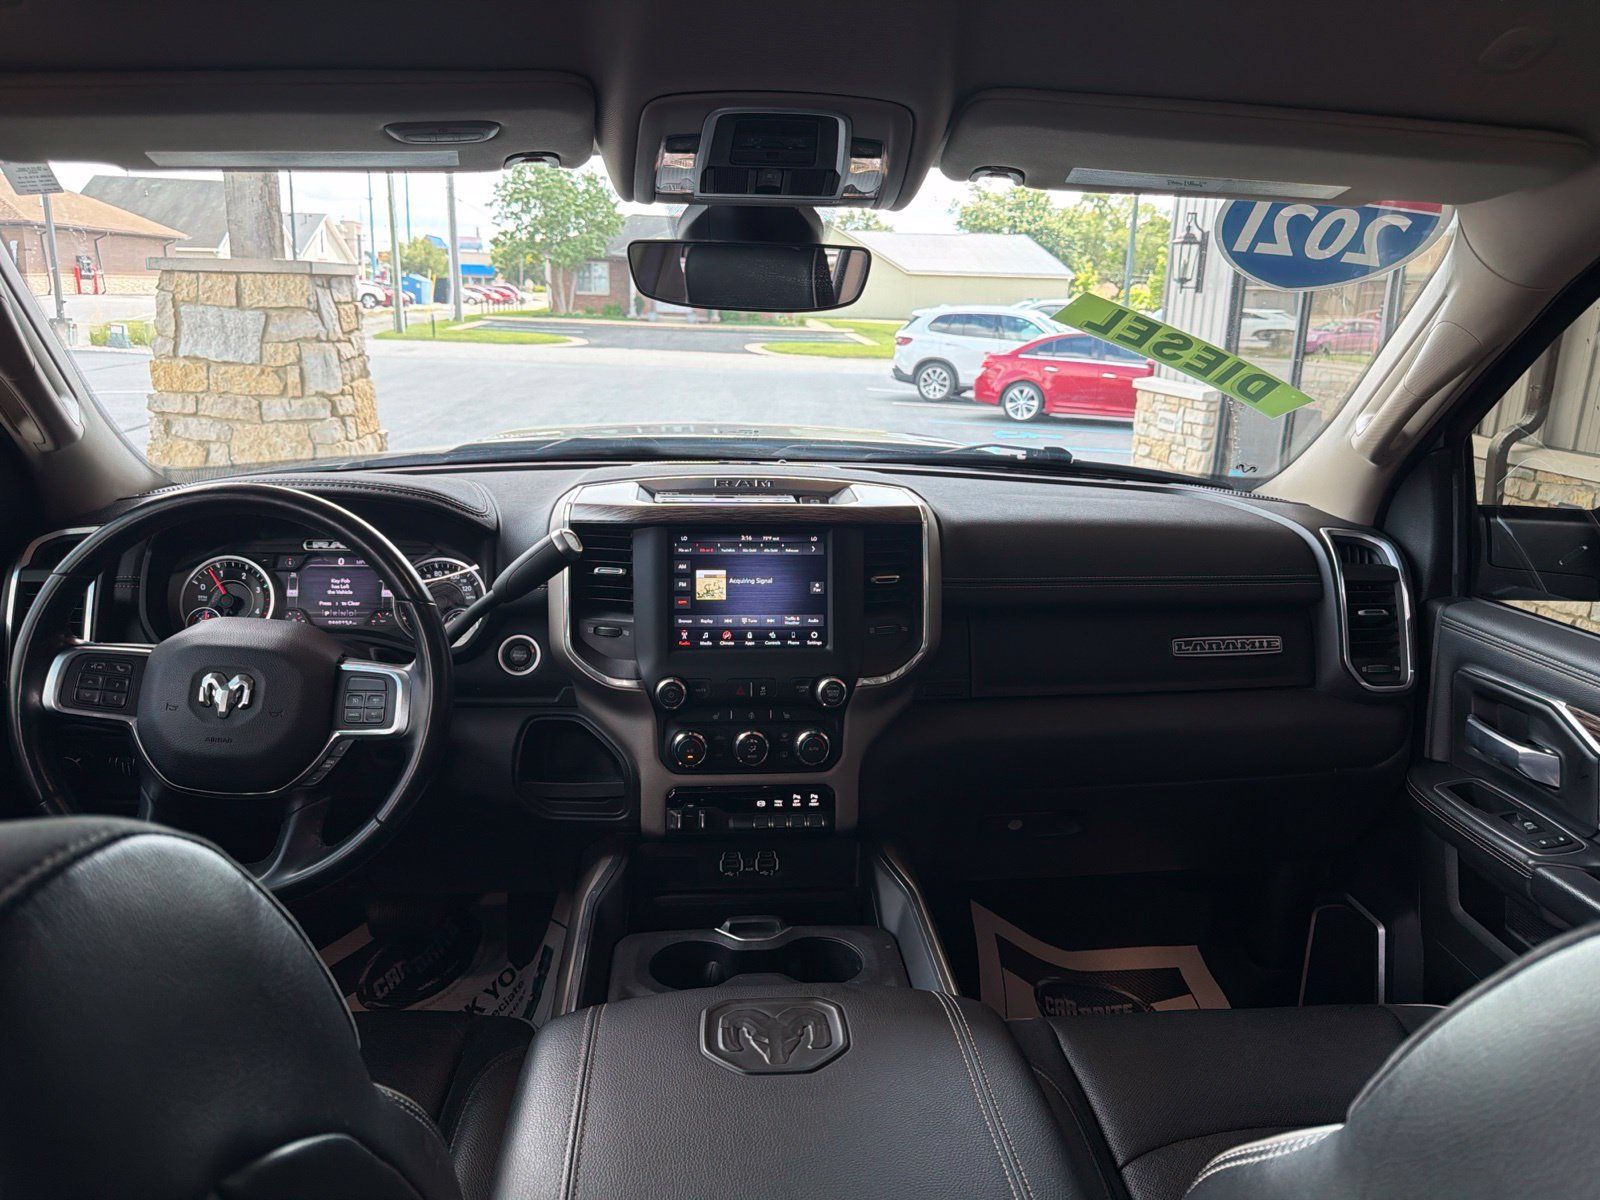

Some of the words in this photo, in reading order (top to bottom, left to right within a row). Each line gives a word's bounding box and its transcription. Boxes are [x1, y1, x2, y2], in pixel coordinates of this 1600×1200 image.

[713, 478, 774, 487] RAM
[313, 541, 347, 549] RA
[338, 557, 345, 566] 0
[242, 572, 247, 580] 2
[1174, 639, 1280, 654] LARAMIE
